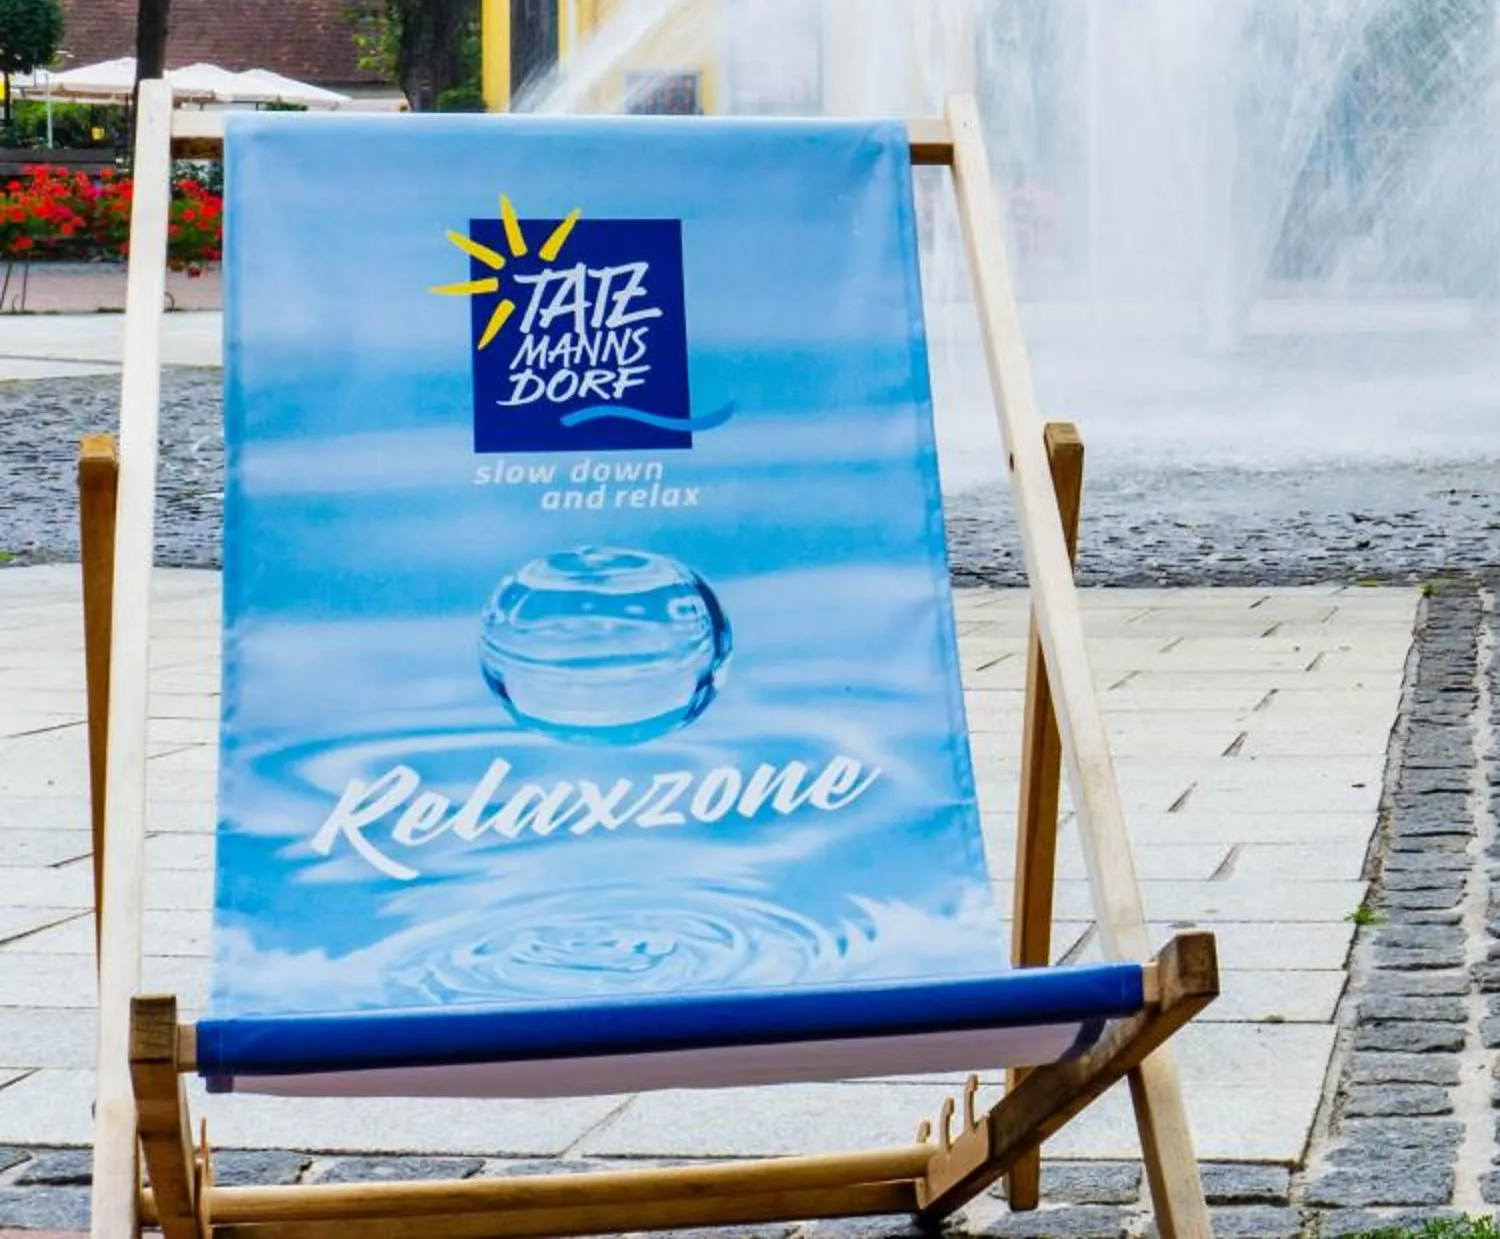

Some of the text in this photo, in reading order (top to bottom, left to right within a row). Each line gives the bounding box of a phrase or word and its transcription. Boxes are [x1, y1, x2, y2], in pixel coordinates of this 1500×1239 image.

[513, 262, 663, 333] TATZ
[509, 326, 649, 370] MANNS
[496, 365, 651, 406] DORF
[473, 457, 663, 485] slow down
[541, 482, 701, 511] and relax
[311, 755, 881, 880] Relaxzone
